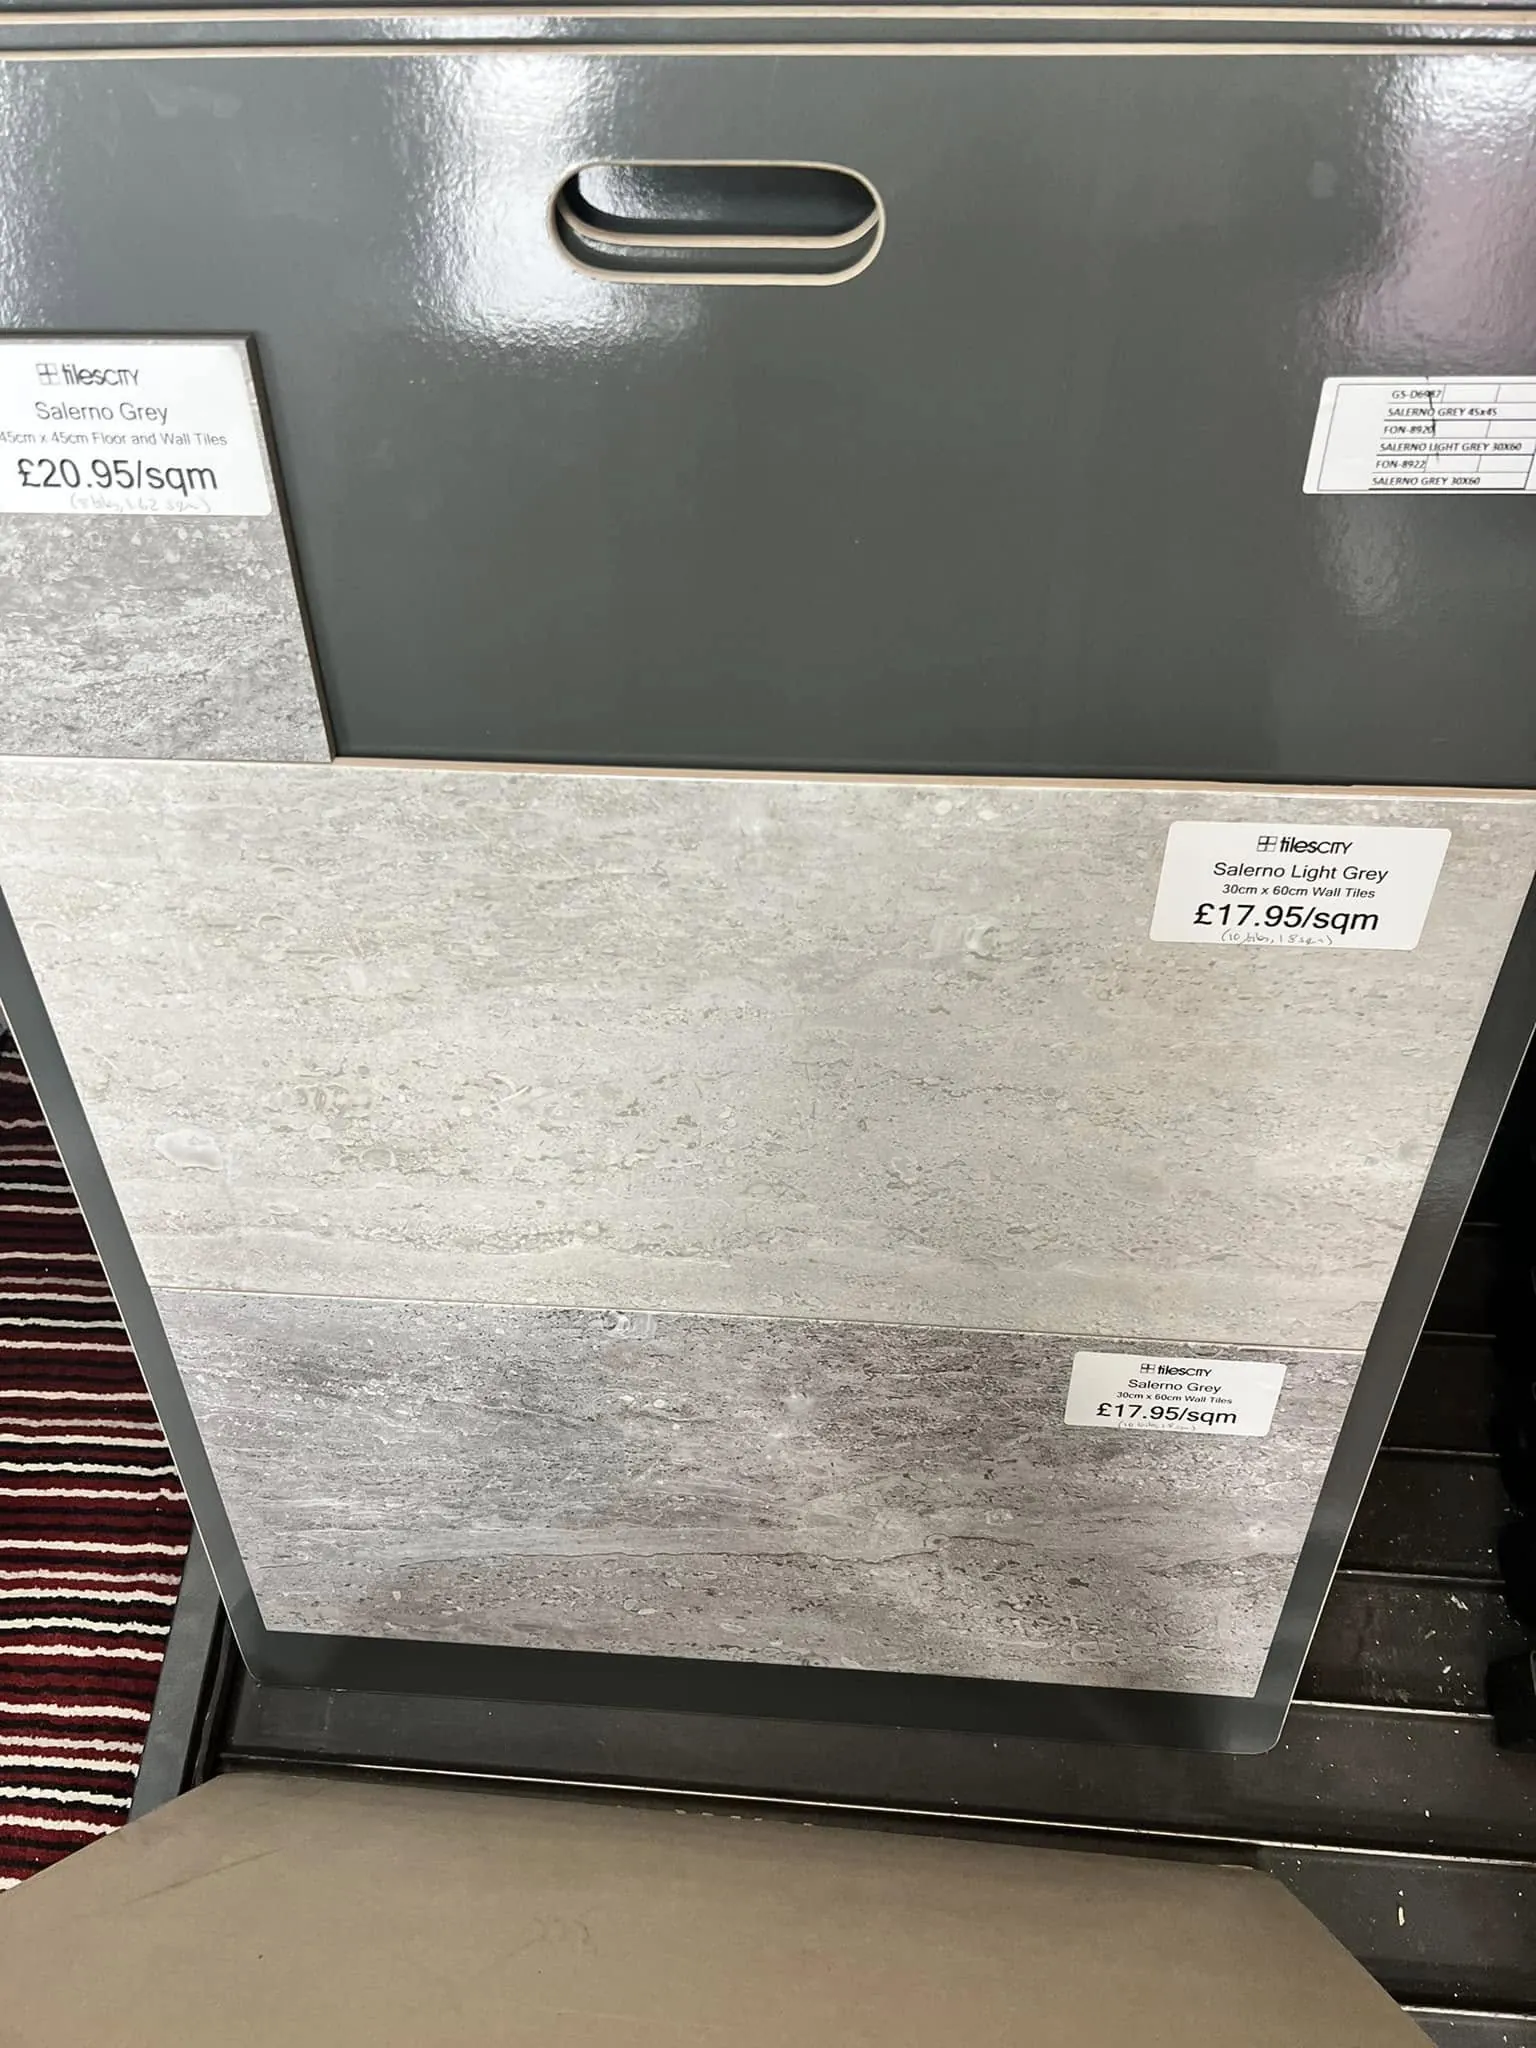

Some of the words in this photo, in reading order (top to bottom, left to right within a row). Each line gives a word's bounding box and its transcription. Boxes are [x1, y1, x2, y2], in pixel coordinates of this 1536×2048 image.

[35, 401, 114, 420] Salerno
[119, 402, 168, 425] Grey
[1387, 407, 1435, 417] SALERNO
[1437, 407, 1467, 417] GREY
[0, 431, 36, 444] 45cm
[40, 434, 48, 443] x
[51, 431, 89, 444] 45cm
[92, 432, 126, 445] Floor
[132, 432, 157, 445] and
[161, 433, 191, 445] Wall
[196, 433, 228, 446] Tiles
[1379, 442, 1427, 452] SALERNO
[1429, 442, 1460, 452] LIGHT
[1461, 442, 1490, 452] GREY
[1492, 442, 1522, 451] 30X60
[1375, 460, 1427, 469] FON-8922
[18, 458, 218, 497] £20.95/sqm
[1371, 476, 1419, 486] SALERNO
[1421, 476, 1448, 486] GREY
[1450, 476, 1481, 486] 30X60
[1213, 862, 1286, 878] Salerno
[1291, 864, 1337, 882] Light
[1342, 866, 1389, 884] Grey
[1222, 884, 1258, 896] 30cm
[1261, 887, 1269, 896] x
[1272, 885, 1308, 897] 60cm
[1312, 887, 1341, 898] Wall
[1345, 888, 1376, 899] Tiles
[1193, 903, 1379, 935] £17.95/sqm
[1127, 1379, 1183, 1391] Salerno
[1187, 1383, 1222, 1395] Grey
[1116, 1391, 1144, 1400] 30cm
[1154, 1393, 1182, 1402] 60cm
[1184, 1395, 1206, 1403] Wall
[1209, 1396, 1233, 1404] Tiles
[1096, 1402, 1237, 1426] £17.95/sqm
